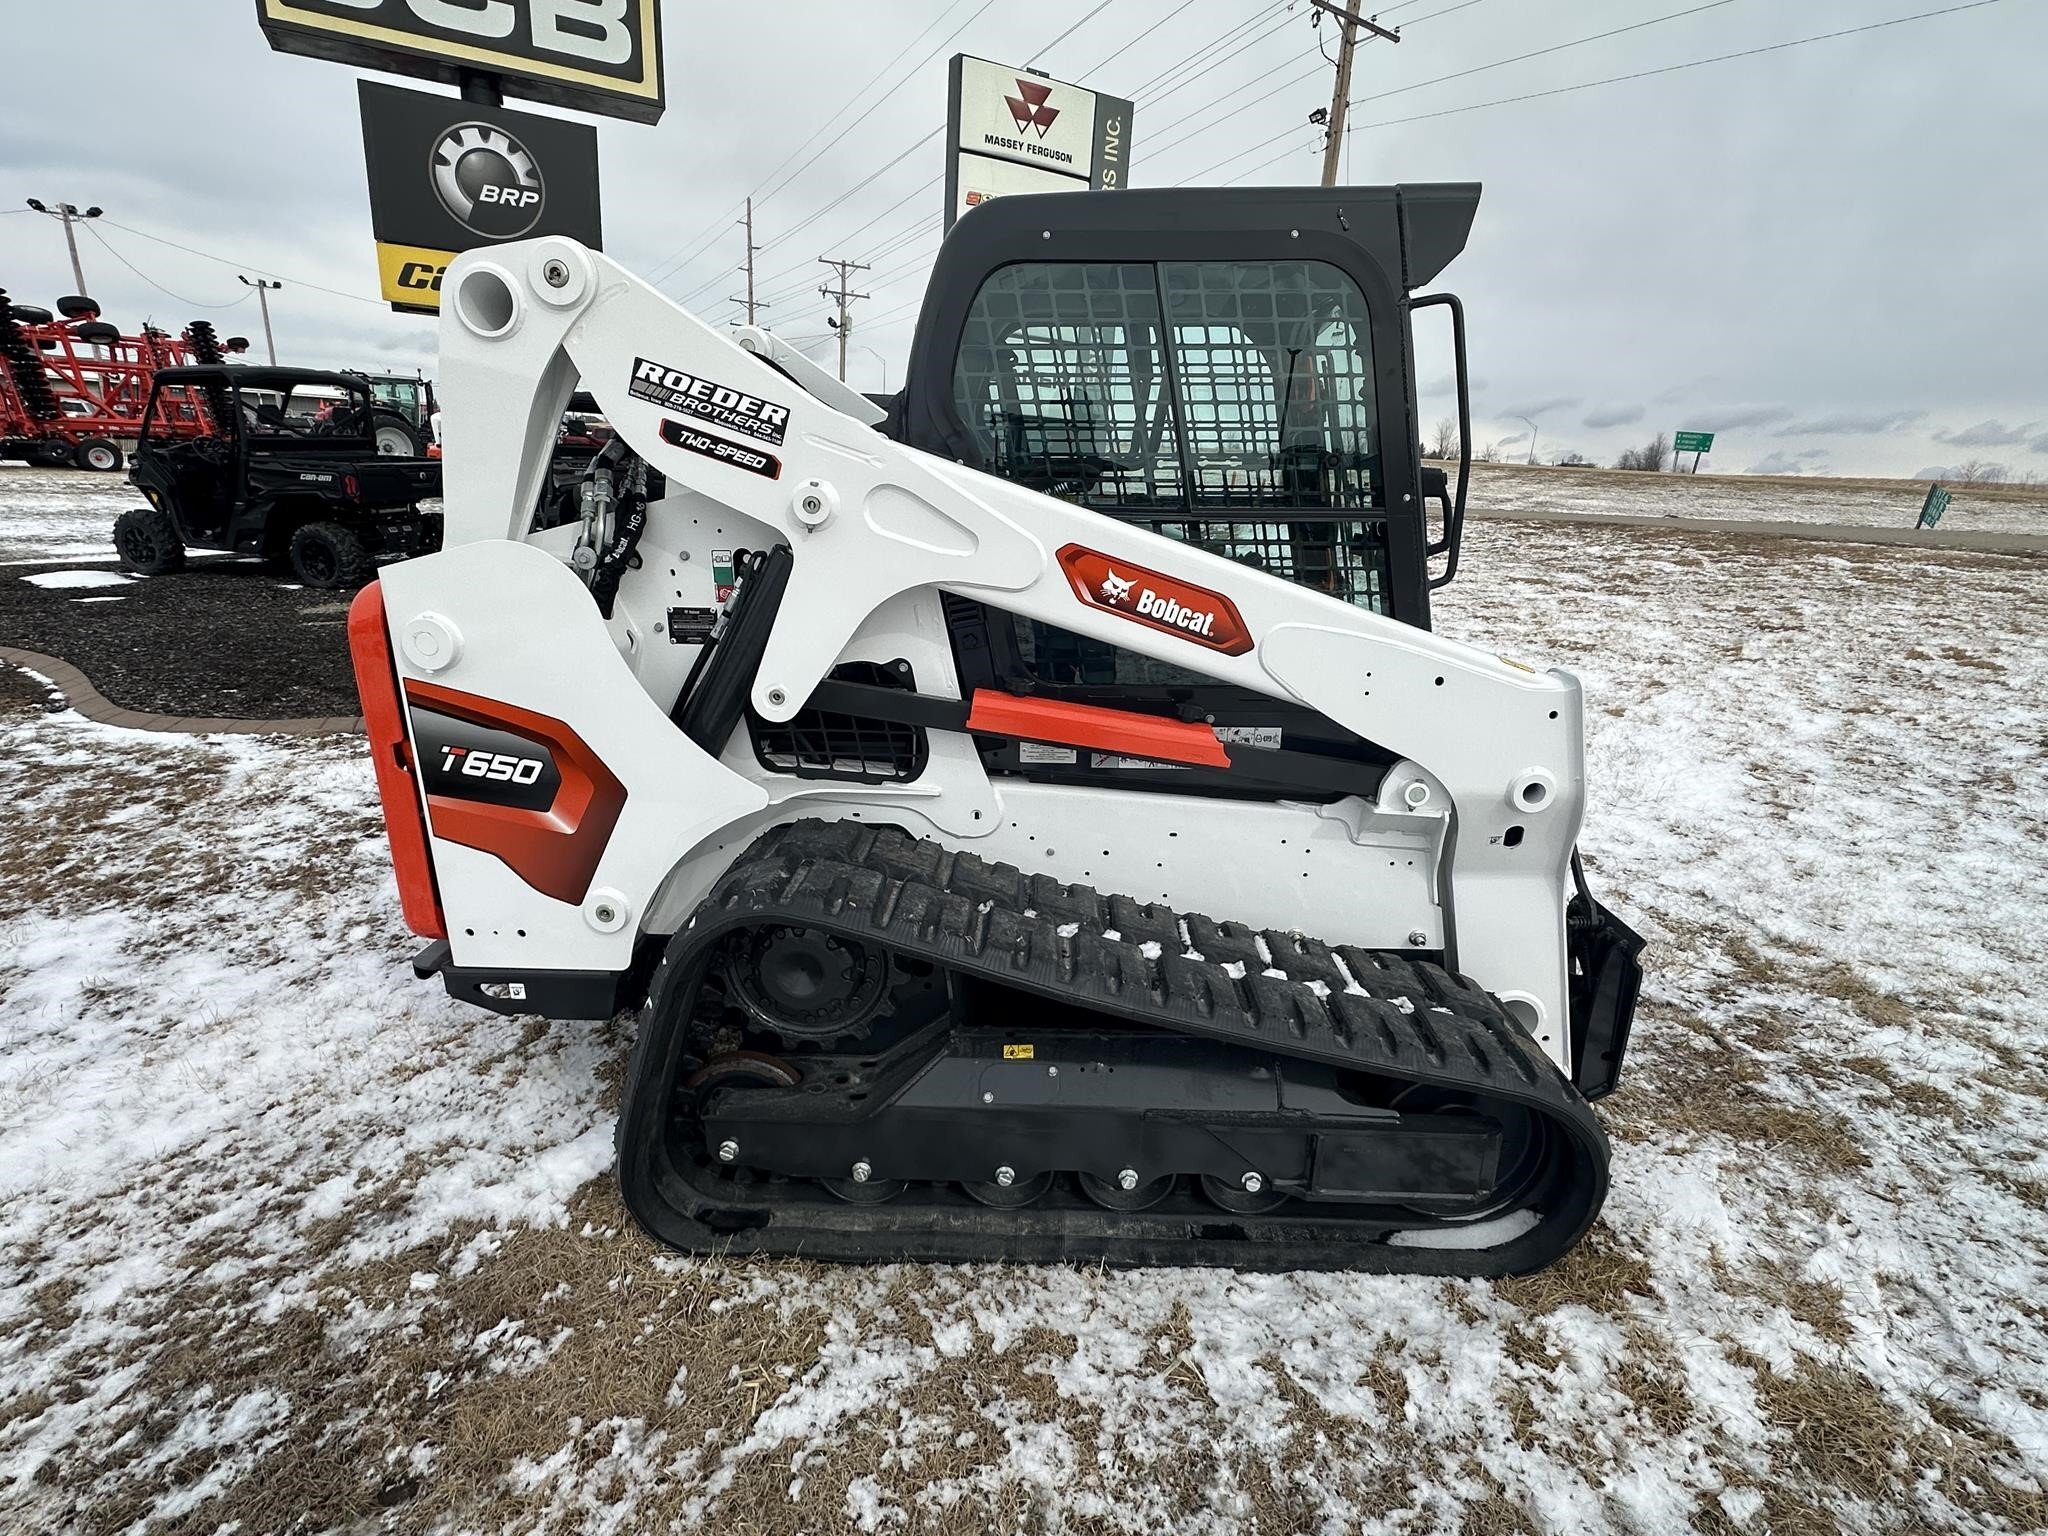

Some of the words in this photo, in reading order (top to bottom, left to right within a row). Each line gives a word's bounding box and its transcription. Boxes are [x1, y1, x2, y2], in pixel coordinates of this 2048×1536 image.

[984, 134, 1024, 151] MASSEY
[1026, 143, 1073, 164] FERGUSON
[1104, 116, 1121, 162] INC.
[479, 184, 540, 208] BRP
[635, 361, 789, 426] ROEDER
[669, 392, 775, 434] BROTHERS
[680, 431, 767, 469] TWO-SPEED
[300, 473, 332, 482] can-am
[1136, 588, 1215, 636] Bobcat
[441, 745, 544, 785] T650
